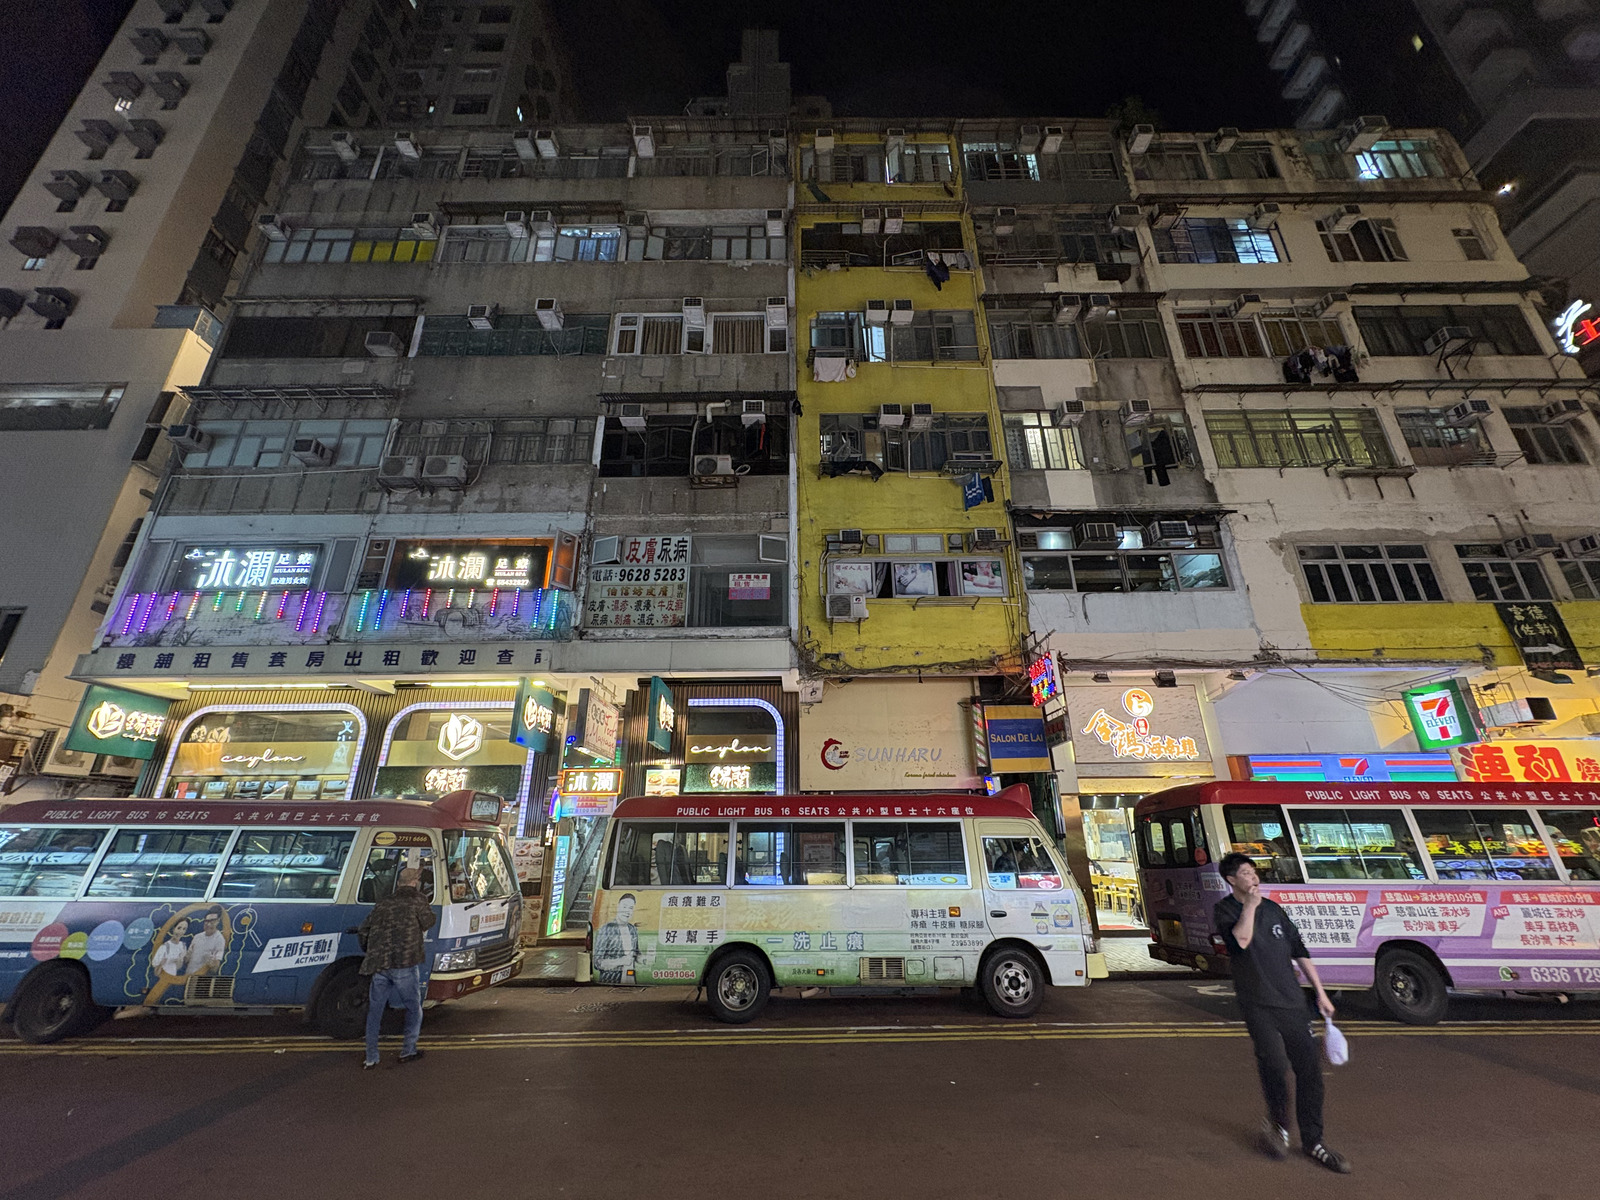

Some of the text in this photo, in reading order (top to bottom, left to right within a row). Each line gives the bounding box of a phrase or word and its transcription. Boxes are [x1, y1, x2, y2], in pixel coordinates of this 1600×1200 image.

[626, 537, 688, 564] 皮膚尿病
[276, 553, 313, 566] 足療
[197, 550, 275, 588] 沐瀾
[428, 555, 485, 580] 沐瀾
[619, 568, 650, 582] 9628
[653, 567, 685, 582] 5283
[990, 733, 1016, 743] SALON
[1017, 733, 1029, 742] DE
[690, 738, 772, 759] ceylon
[854, 746, 943, 763] SUNHARU
[220, 749, 304, 768] ceylon
[568, 771, 614, 792] 沐瀾
[1305, 790, 1343, 800] PUBLIC
[1350, 790, 1381, 800] LIGHT
[1388, 790, 1411, 800] BUS
[1418, 790, 1430, 800] 19
[1437, 790, 1474, 800] SEATS
[43, 809, 381, 823] PUBLIC LIGHT BUS 16 SEATS 公共小型巴士十六座位
[676, 806, 975, 816] PUBLIC LIGHT BUS 16 SEATS 公共小型巴士十六座位
[668, 895, 721, 907] 痕癢難忍
[911, 908, 947, 919] 專科主理
[1340, 905, 1360, 916] 生日
[665, 930, 718, 944] 好幫手
[767, 931, 864, 951] 一洗止癢
[1555, 934, 1577, 946] 太子
[268, 938, 333, 960] 立即行動!
[295, 956, 309, 965] ACT
[653, 970, 695, 978] 91091064
[1530, 967, 1571, 983] 6336
